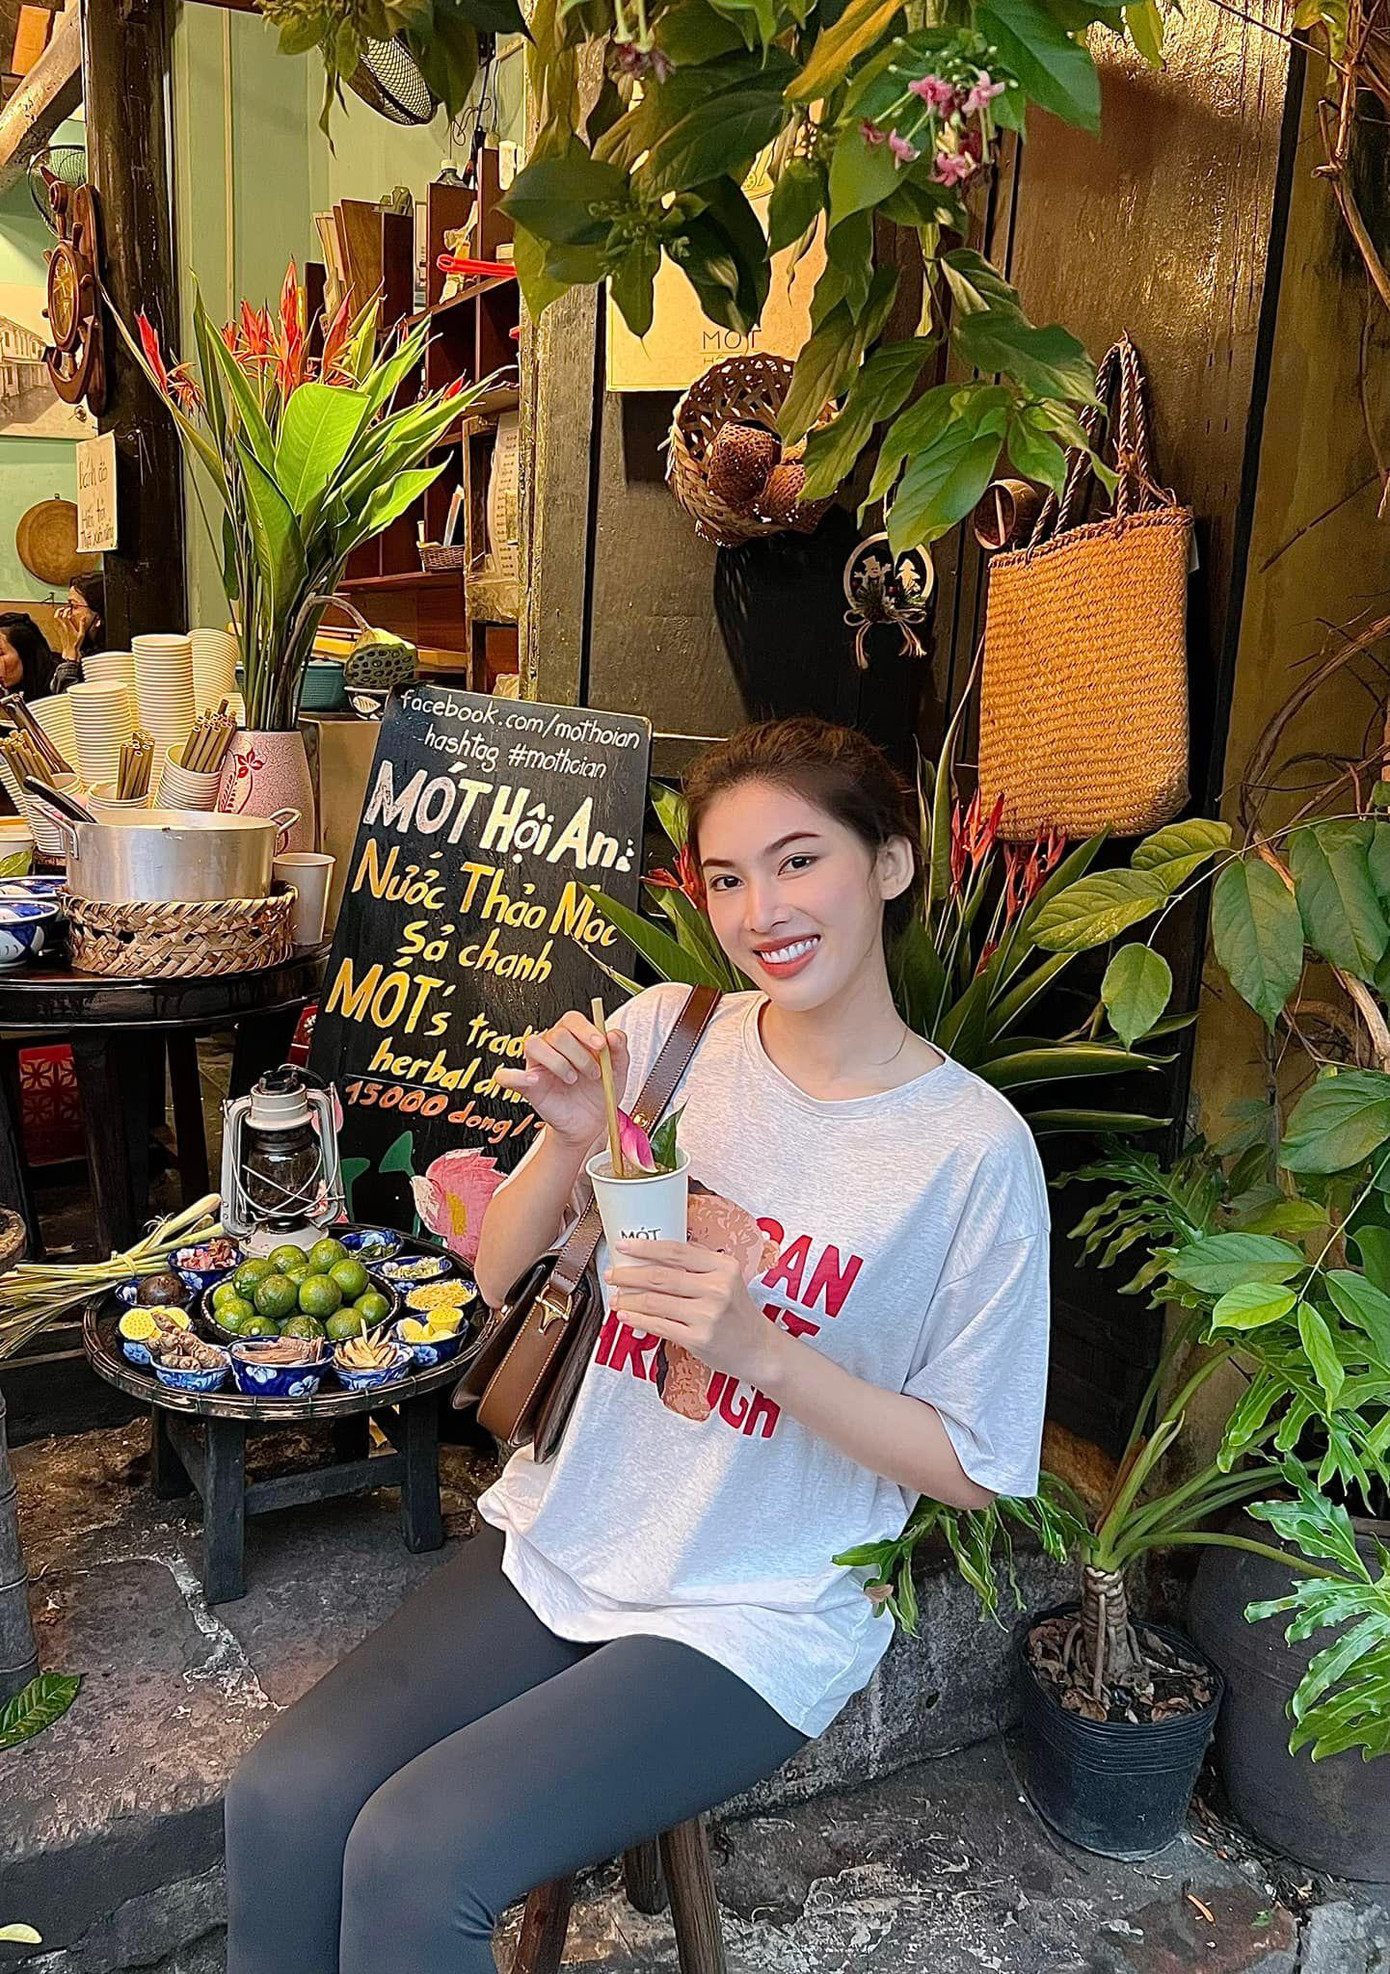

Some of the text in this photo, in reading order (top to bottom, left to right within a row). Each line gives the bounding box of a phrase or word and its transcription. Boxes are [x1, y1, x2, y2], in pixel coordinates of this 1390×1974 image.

[400, 689, 641, 750] facebook.com/mothoian
[424, 724, 607, 779] hashtag #mothoian
[363, 760, 493, 844] MÓT
[479, 785, 556, 864] Hội
[460, 861, 548, 930] Thảo
[458, 927, 554, 984] chanh
[325, 955, 457, 1037] MÓT's
[368, 1037, 482, 1093] herbal
[345, 1080, 449, 1117] 15000
